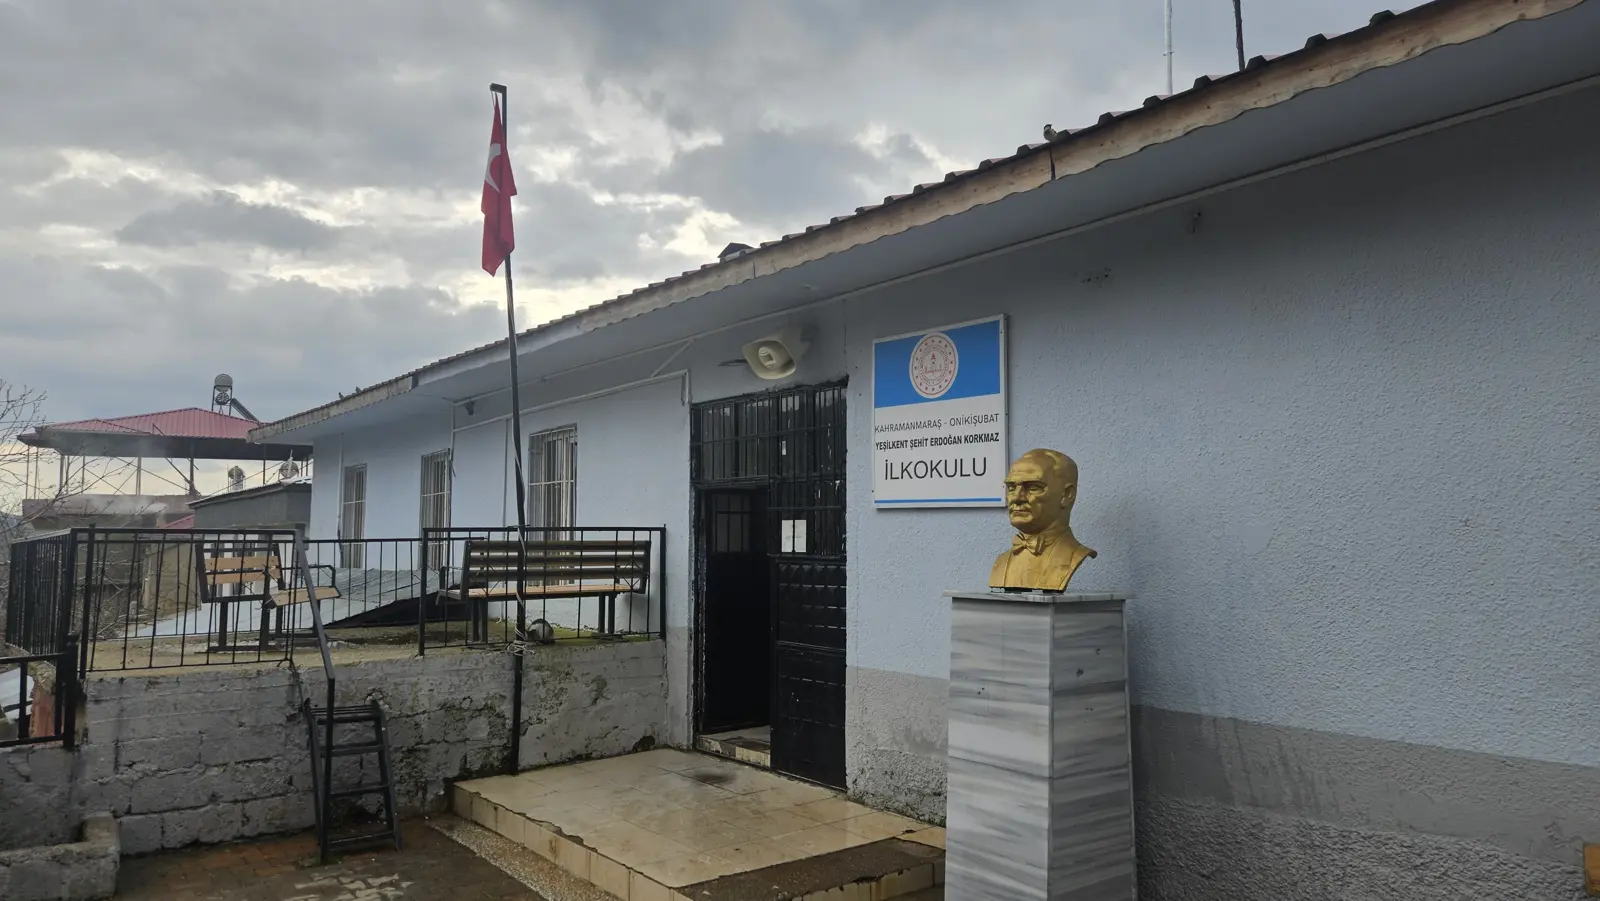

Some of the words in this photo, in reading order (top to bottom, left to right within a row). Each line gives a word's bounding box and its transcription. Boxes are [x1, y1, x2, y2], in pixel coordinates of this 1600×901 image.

[874, 419, 942, 433] KAHRAMANMARAŞ
[949, 413, 1000, 427] ONİKİŞUBAT
[875, 439, 909, 452] YEŞİLKENT
[909, 436, 929, 450] ŞEHİT
[930, 434, 962, 446] ERDOĞAN
[963, 432, 1000, 444] KORKMAZ
[884, 457, 987, 480] İLKOKULU
